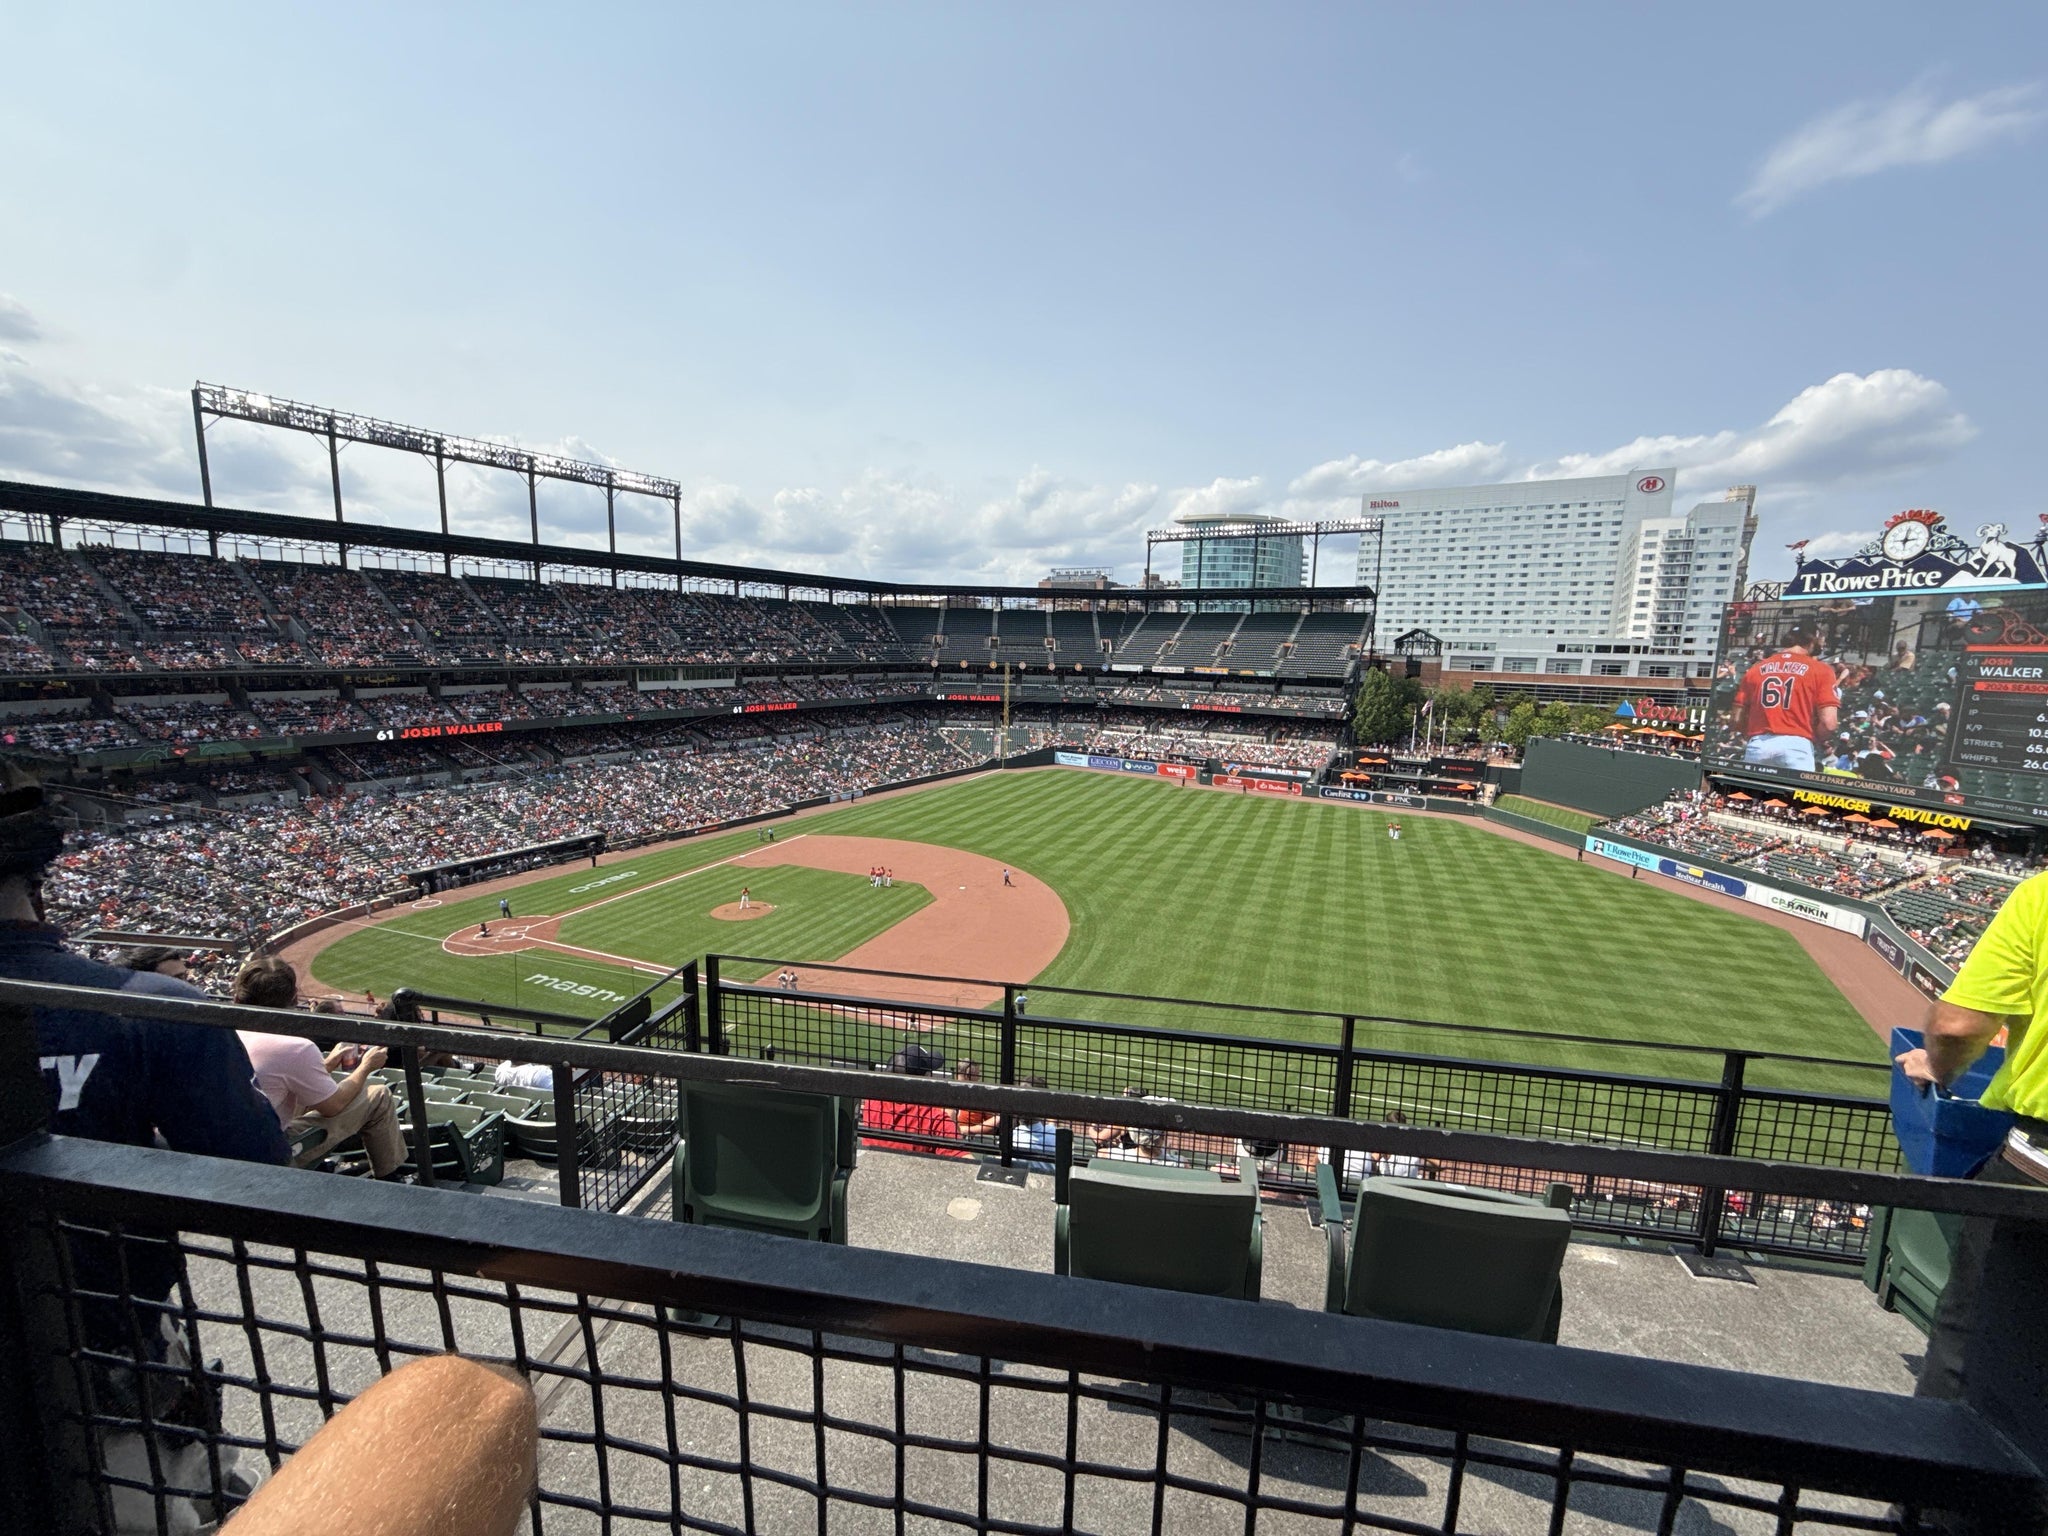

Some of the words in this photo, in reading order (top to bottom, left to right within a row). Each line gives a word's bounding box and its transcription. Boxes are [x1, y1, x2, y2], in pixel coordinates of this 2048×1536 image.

[1370, 500, 1399, 508] Hilton
[1981, 658, 2013, 666] JOSH
[1760, 661, 1809, 676] WALKER
[1980, 666, 2043, 678] WALKER
[1761, 676, 1795, 710] 61
[733, 705, 742, 714] 61
[744, 704, 766, 712] JOSH
[767, 702, 797, 711] WALKER
[1635, 697, 1687, 723] Coors
[1632, 717, 1667, 728] ROOF
[376, 730, 394, 741] 61
[400, 726, 442, 739] JOSH
[445, 722, 503, 735] WALKER
[1963, 739, 2004, 748] STRIKE%
[1960, 753, 1998, 763] WHIFF%
[1132, 763, 1155, 771] VANDA
[1166, 767, 1187, 775] weis
[1799, 772, 1827, 780] ORIOLE
[1827, 776, 1846, 785] PARK
[1854, 780, 1888, 791] CAMDEN
[1888, 786, 1916, 796] YARDS
[1324, 789, 1353, 799] CareFirst
[1394, 796, 1411, 804] PNC
[1793, 790, 1872, 813] PUREWAGER
[1889, 805, 1973, 831] PAVILION
[1974, 800, 2004, 809] CURRENT
[2005, 804, 2025, 812] TOTAL
[1675, 871, 1701, 884] MedStar
[1702, 879, 1726, 892] Health
[1787, 901, 1829, 919] RANKIN
